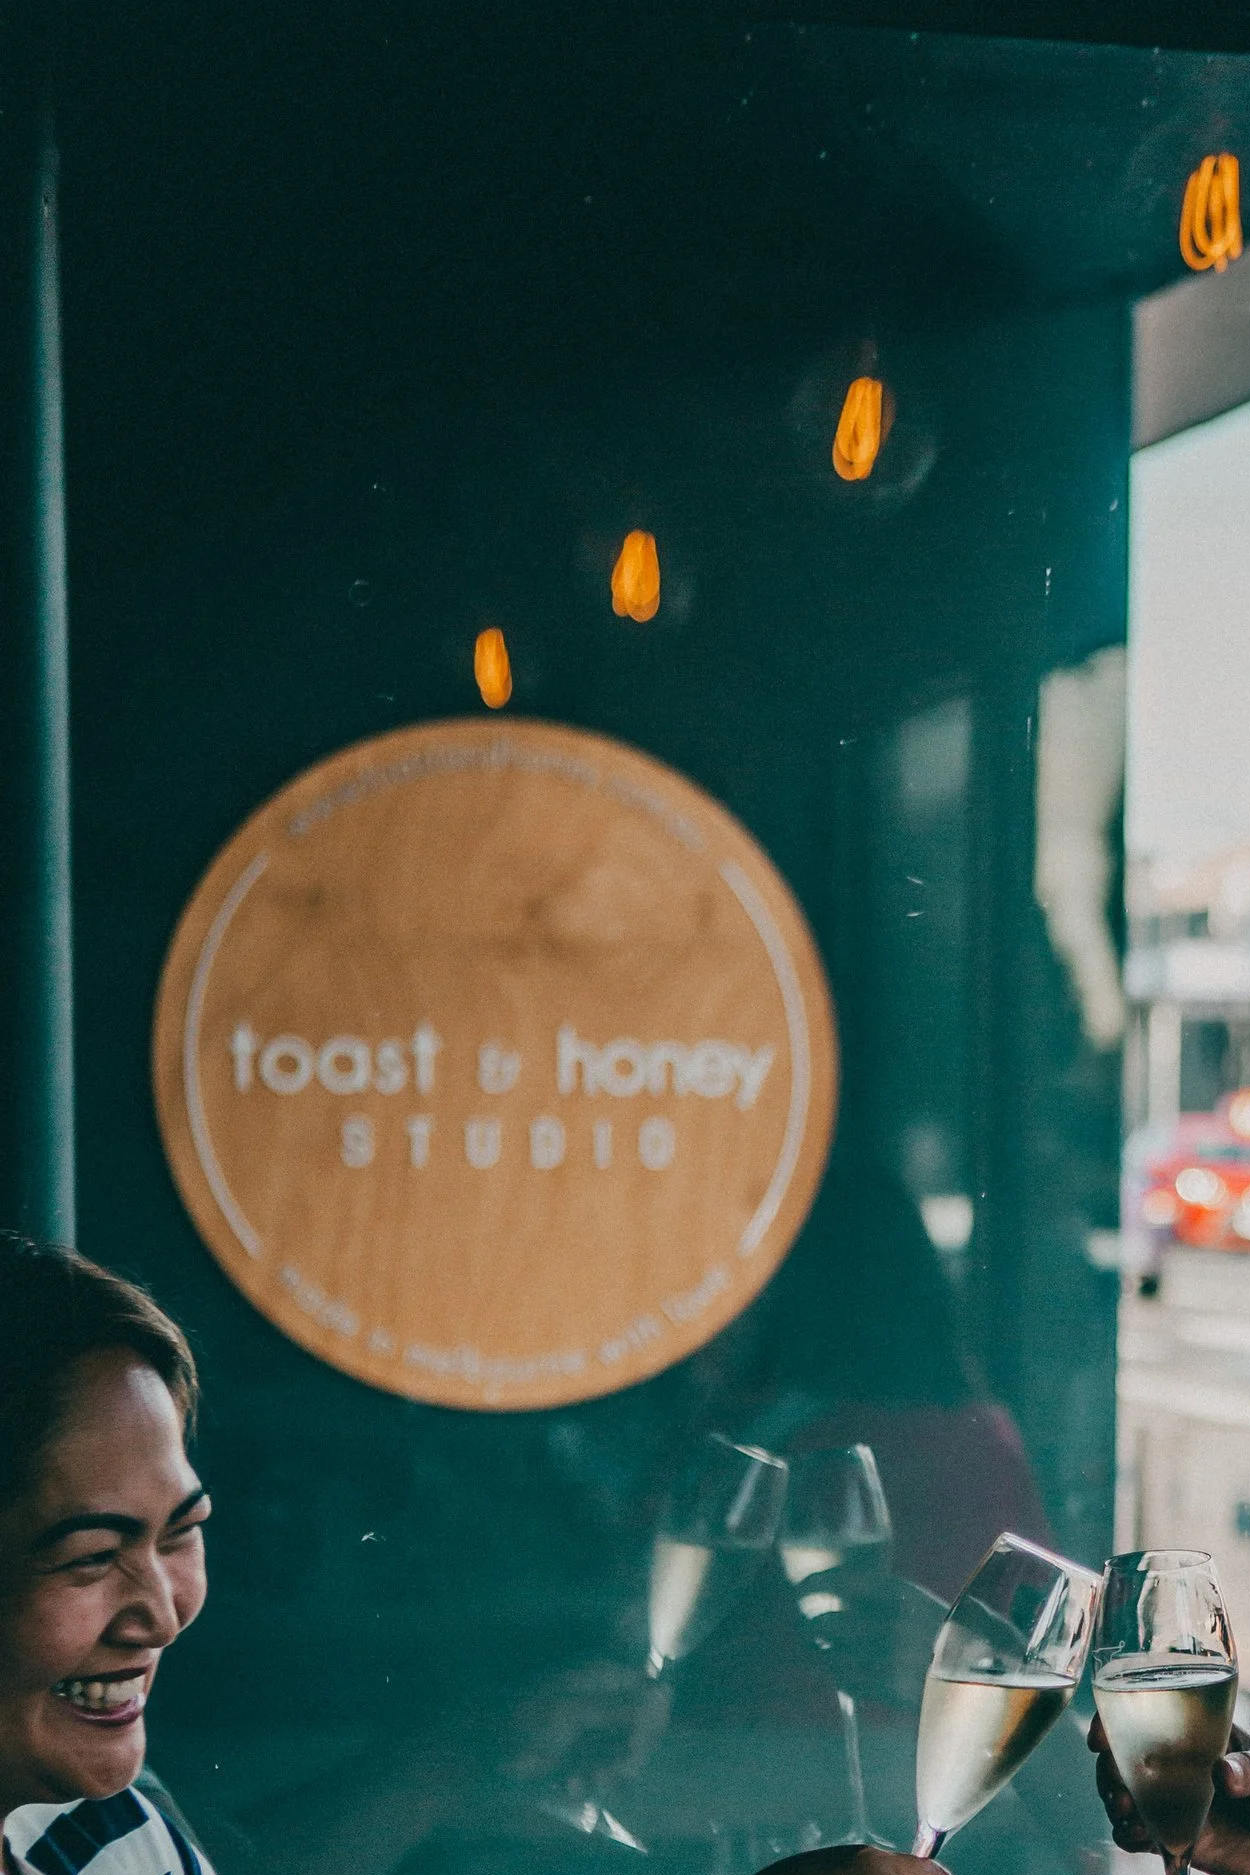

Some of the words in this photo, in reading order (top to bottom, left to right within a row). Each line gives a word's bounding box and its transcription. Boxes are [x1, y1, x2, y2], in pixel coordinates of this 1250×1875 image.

[230, 1020, 442, 1097] toast
[556, 1021, 776, 1111] honey
[339, 1112, 677, 1172] STUDIO
